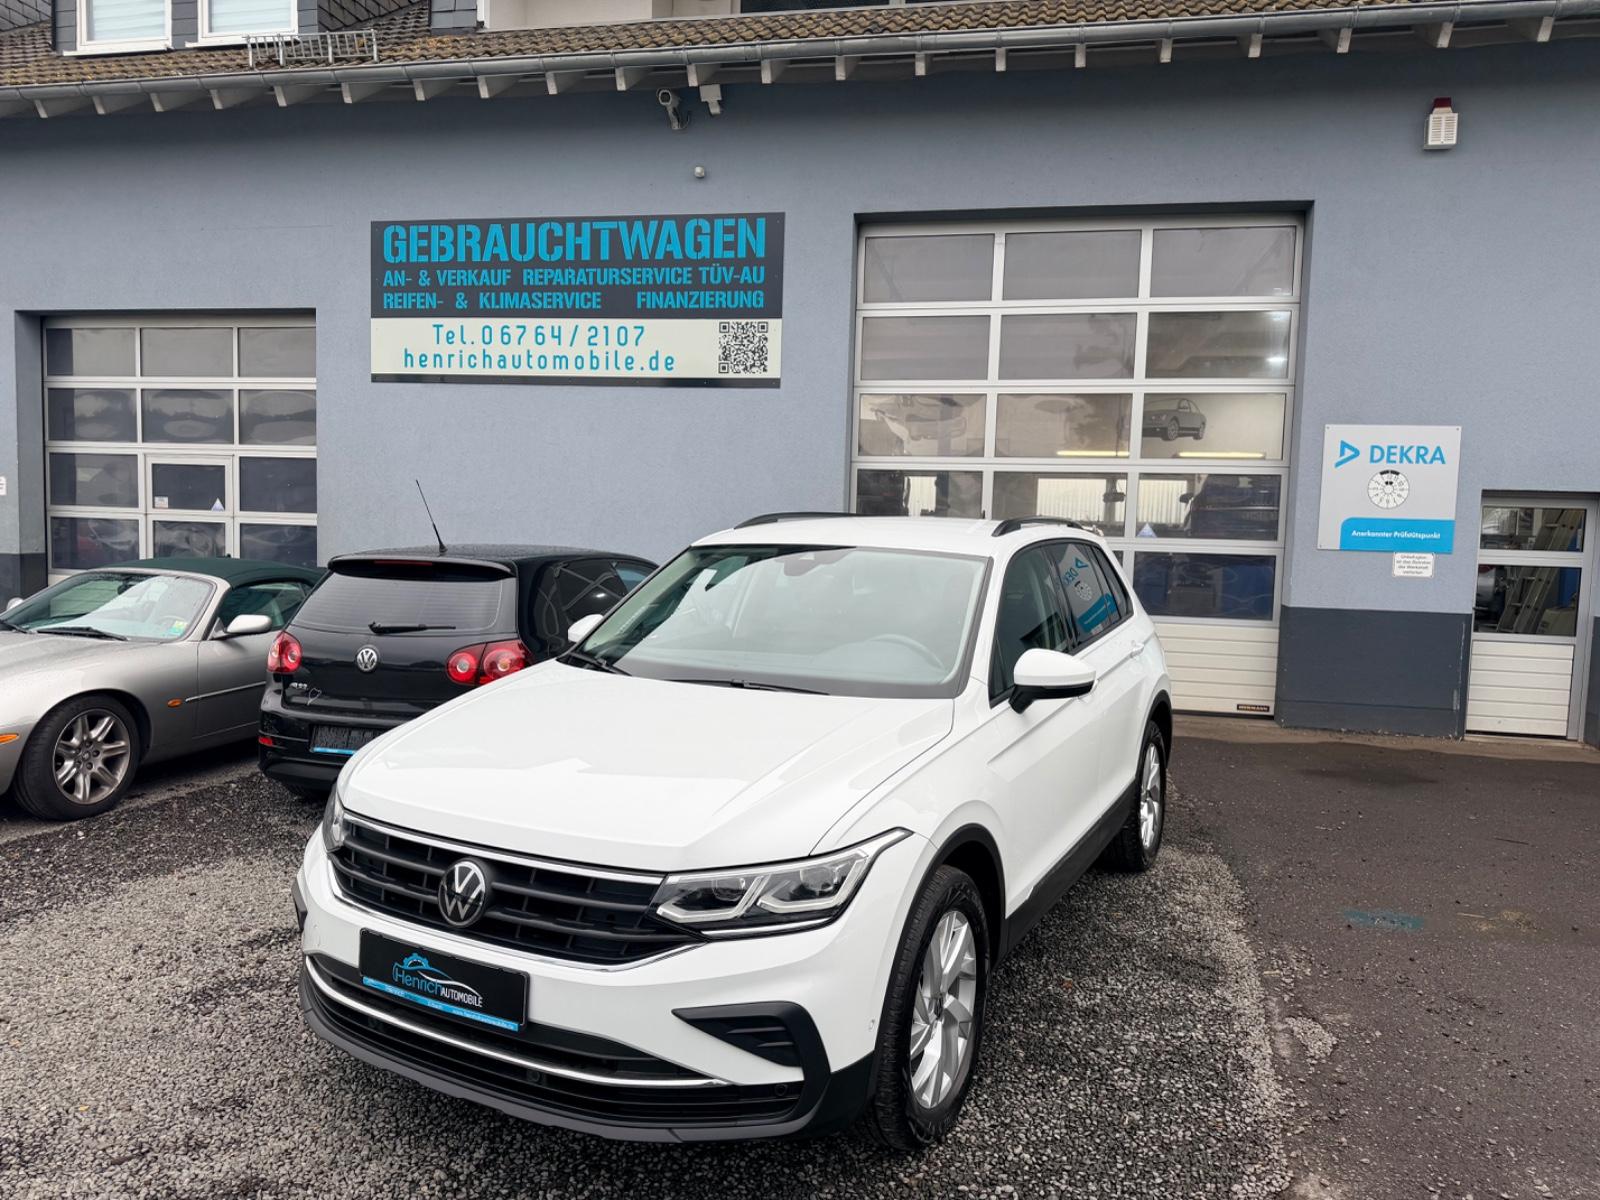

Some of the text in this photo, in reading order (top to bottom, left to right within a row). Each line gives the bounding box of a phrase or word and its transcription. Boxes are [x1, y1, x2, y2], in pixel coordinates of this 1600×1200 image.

[383, 217, 767, 265] GEBRAUCHTWAGEN
[383, 265, 765, 287] AN- & VERKAUF REPARATURSERVICE TÜV-AU
[383, 290, 765, 310] REIFEN- & KLIMASERVICE FINANZIERUNG
[403, 348, 675, 372] henrichautomobile.de
[1369, 444, 1446, 465] DEKRA
[1352, 530, 1392, 538] Anerkannter
